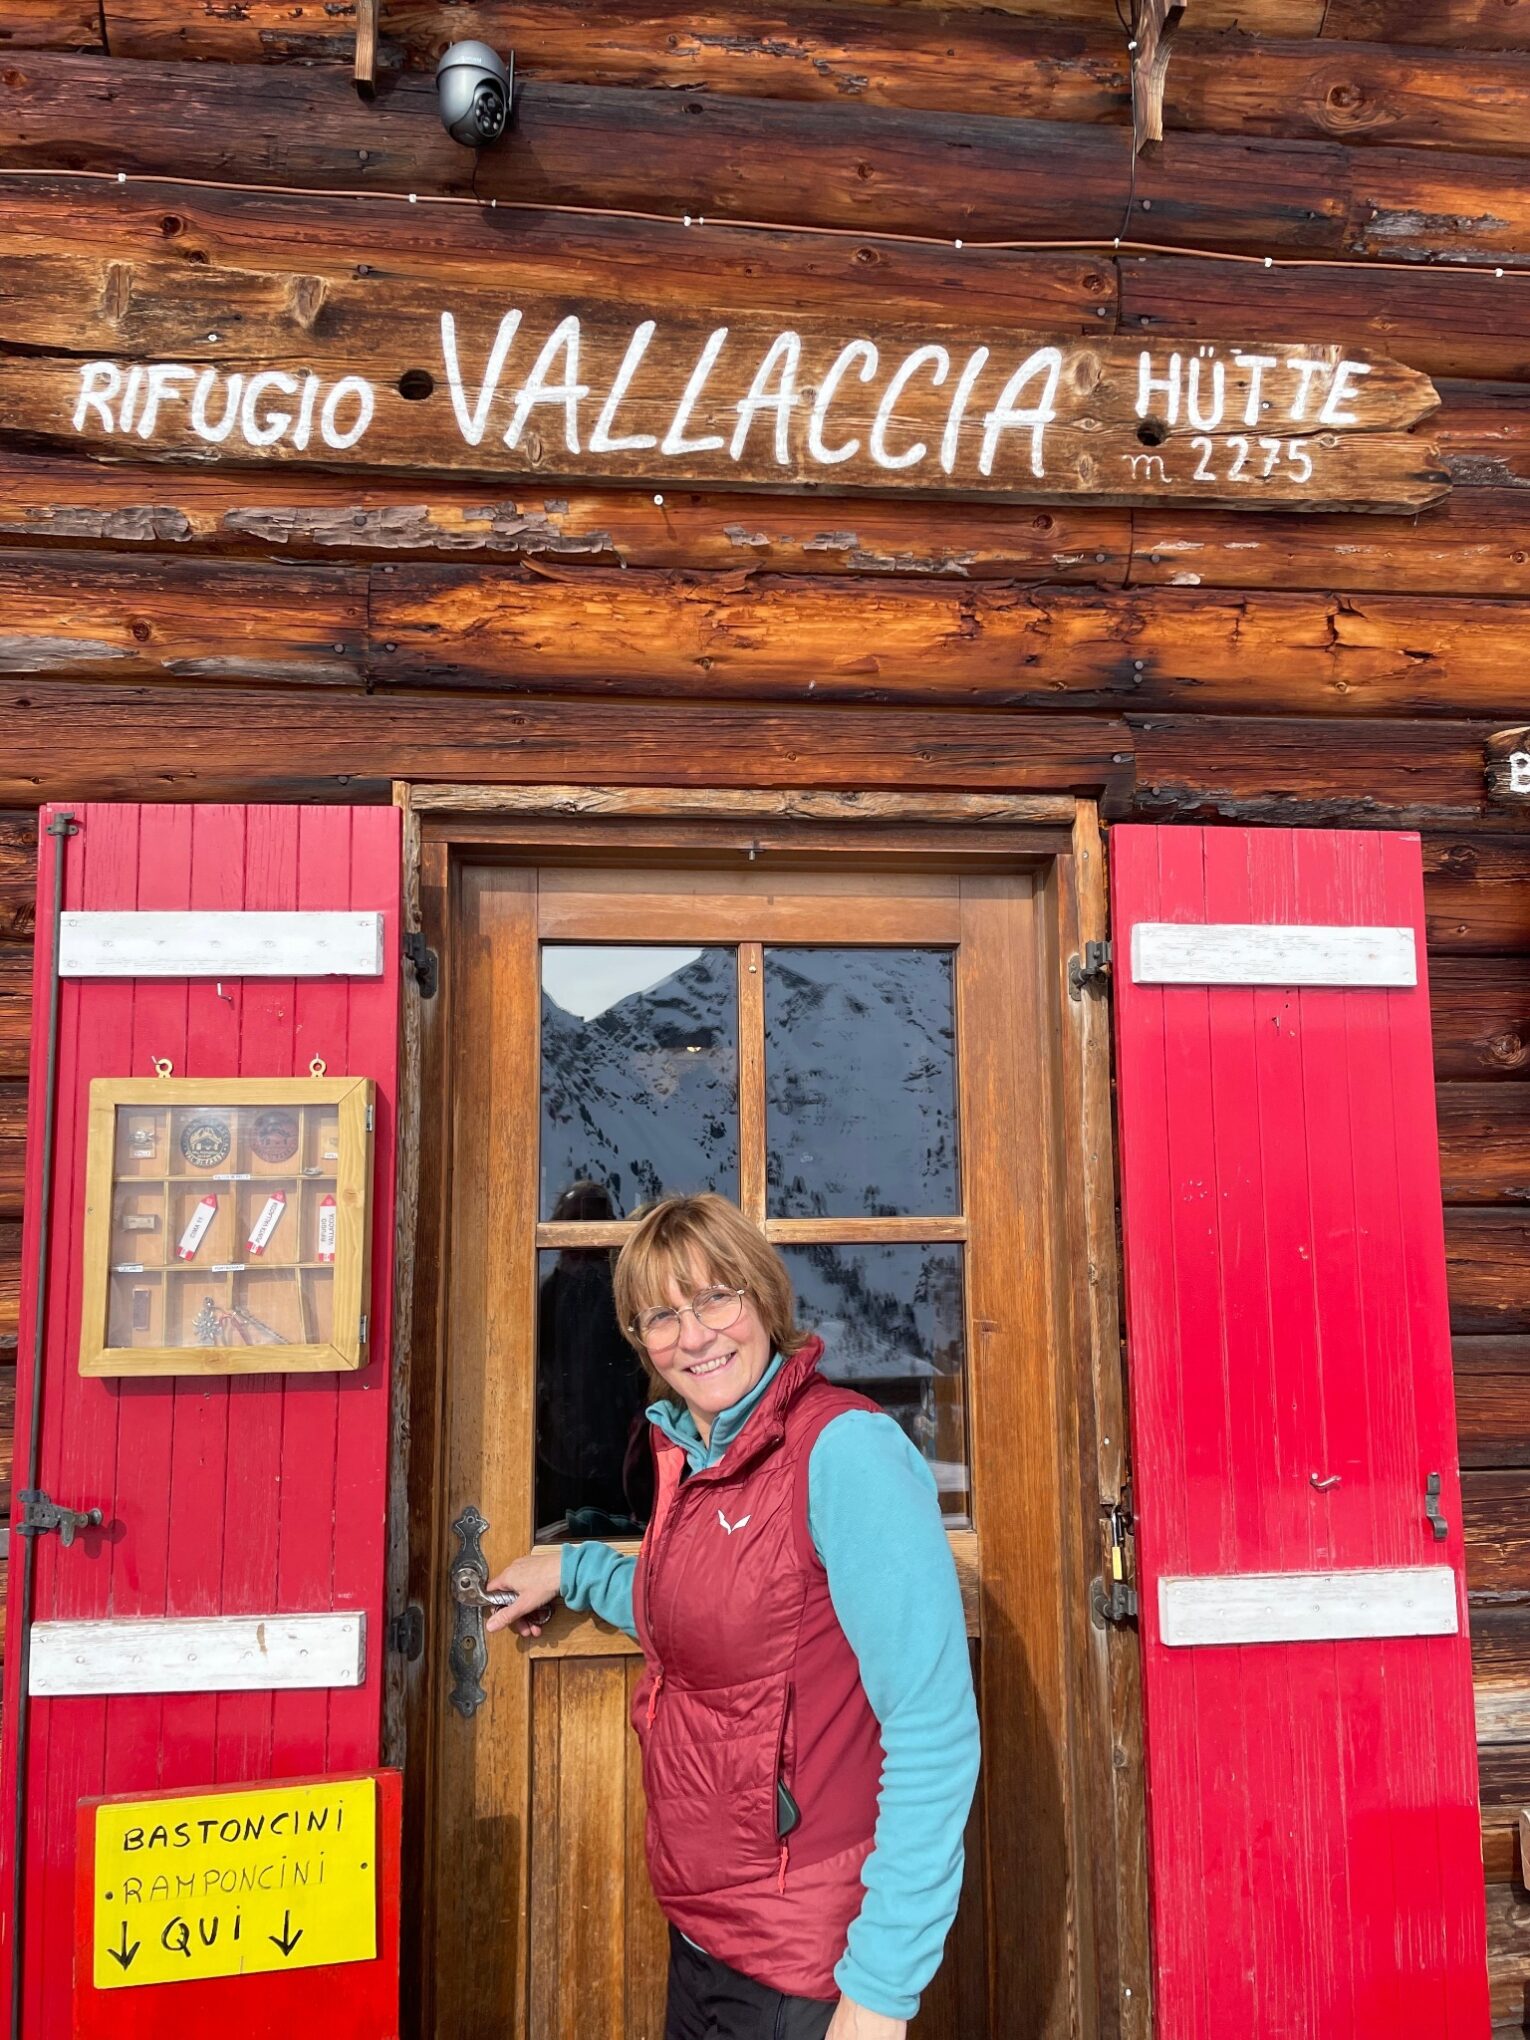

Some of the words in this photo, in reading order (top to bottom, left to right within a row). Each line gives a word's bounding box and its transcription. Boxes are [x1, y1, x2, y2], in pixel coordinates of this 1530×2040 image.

[72, 361, 375, 450] RIFUGIO
[440, 308, 1064, 478] VALLACCIA
[1136, 344, 1372, 431] HÜTTE
[1190, 436, 1314, 484] 2275
[123, 1800, 342, 1851] BASTONCINI
[122, 1851, 325, 1905] RAMPONCINI
[161, 1905, 241, 1957] QUI
